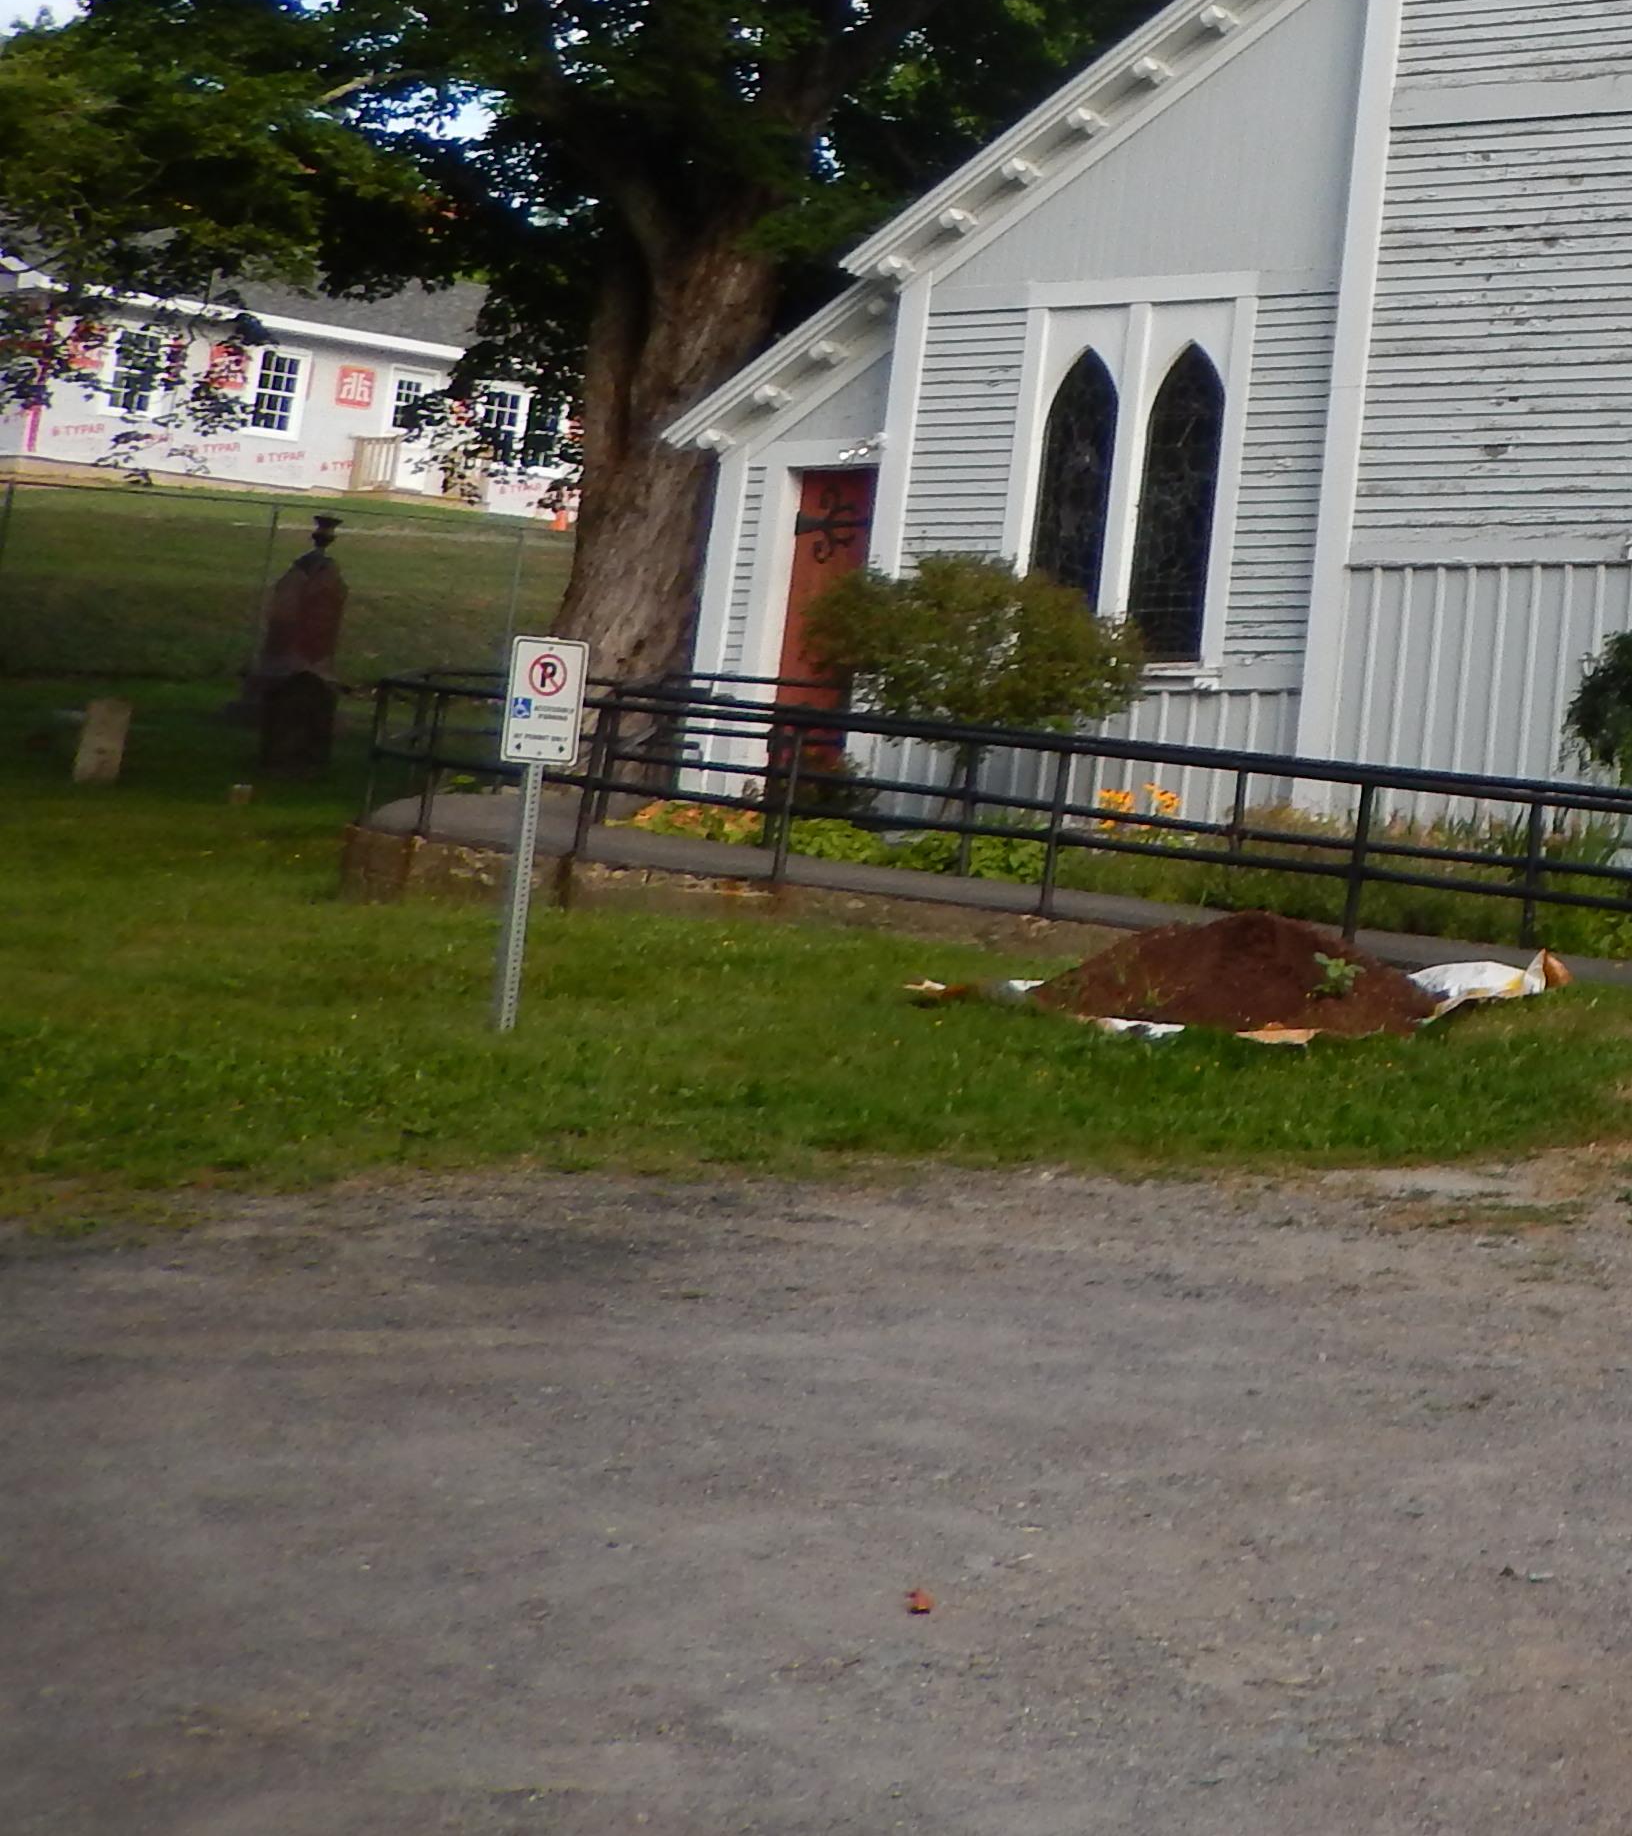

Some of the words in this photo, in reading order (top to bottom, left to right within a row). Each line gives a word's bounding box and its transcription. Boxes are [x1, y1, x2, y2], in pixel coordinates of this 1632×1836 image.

[65, 423, 105, 435] TYPAR
[203, 442, 241, 453] TYPAR
[268, 451, 306, 463] TYPAR
